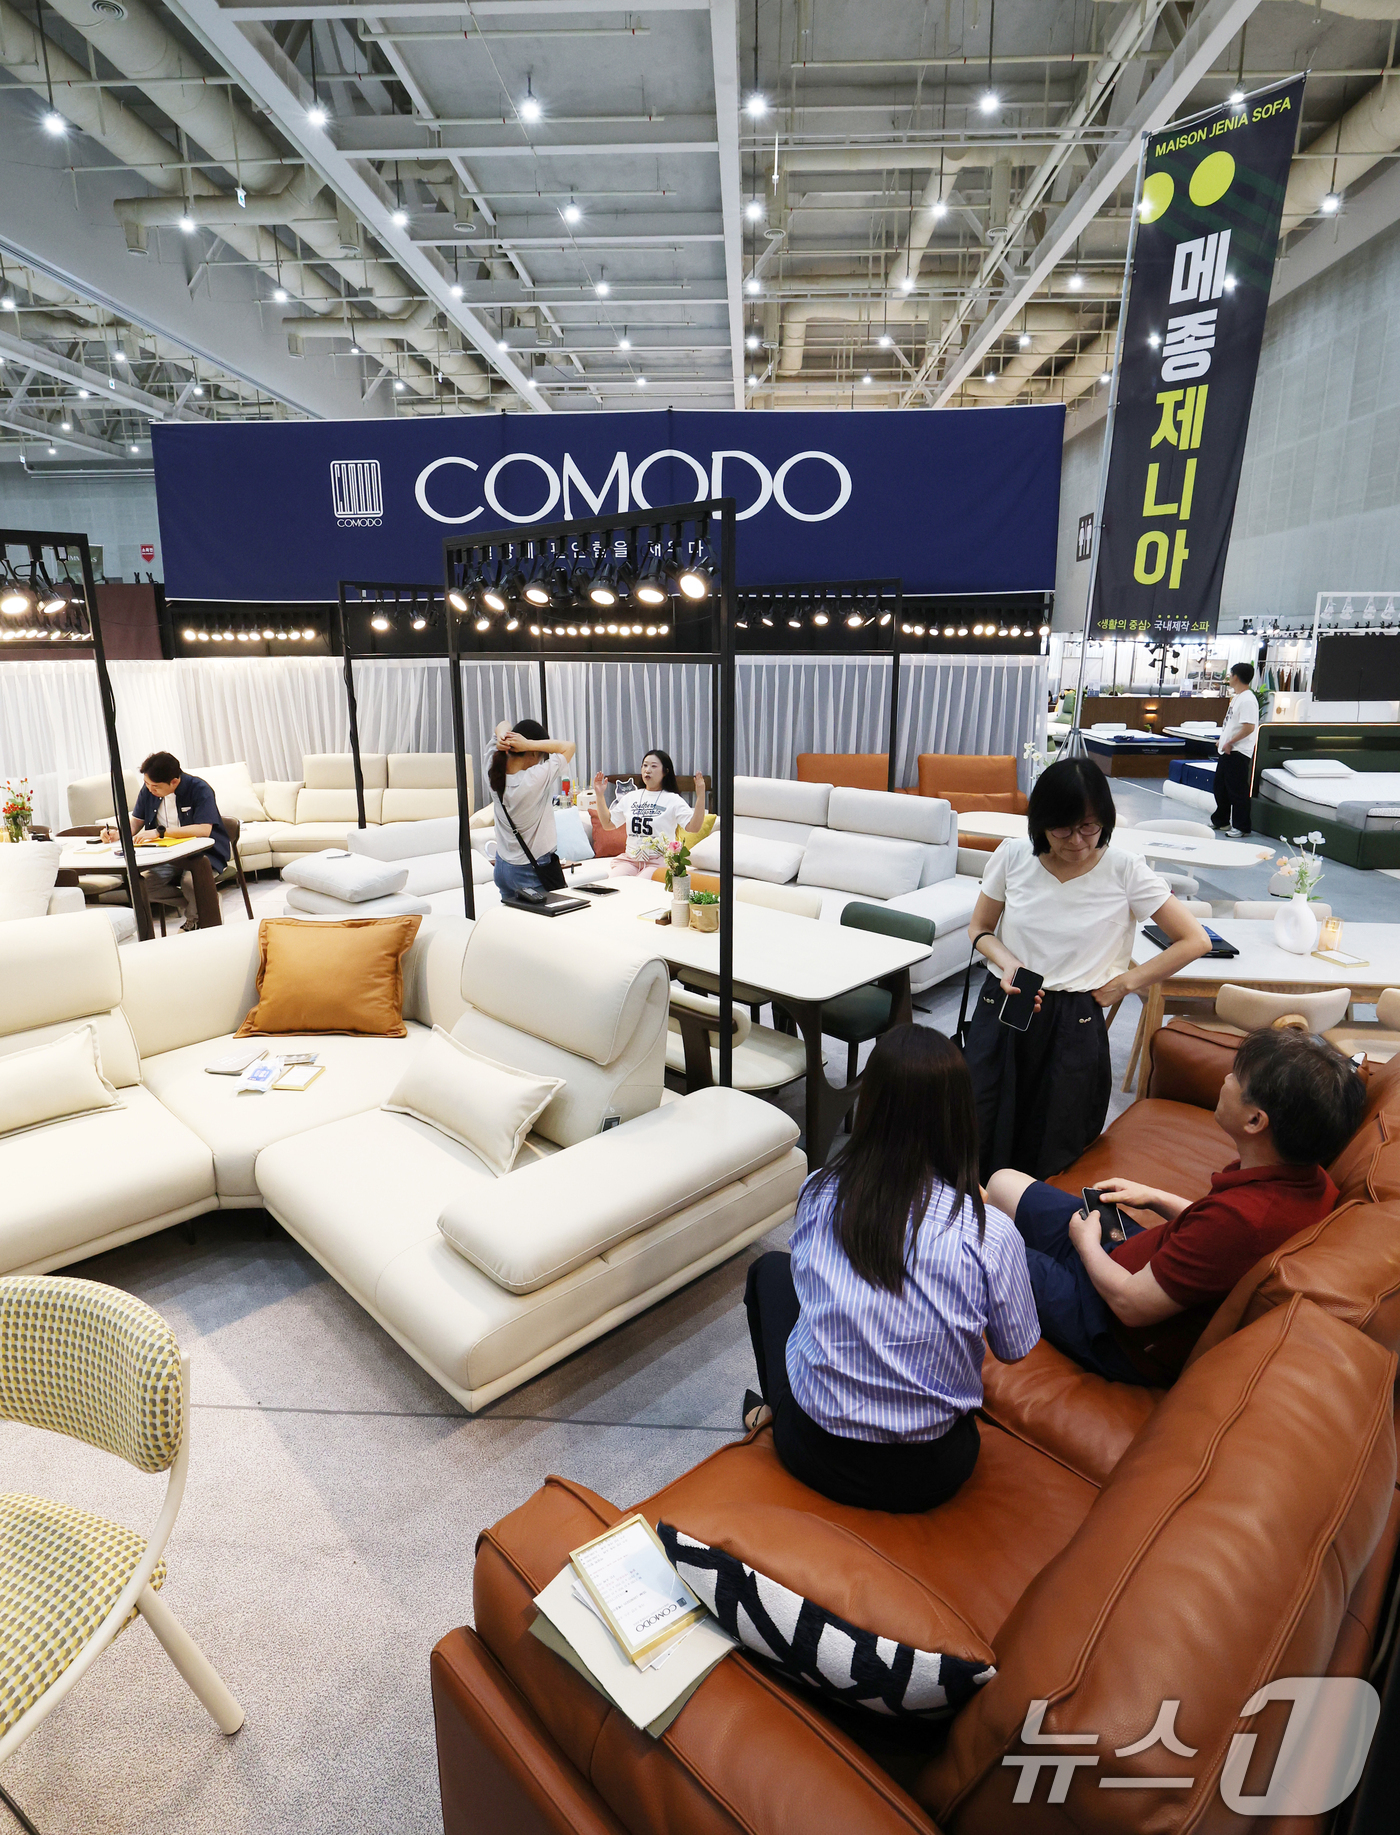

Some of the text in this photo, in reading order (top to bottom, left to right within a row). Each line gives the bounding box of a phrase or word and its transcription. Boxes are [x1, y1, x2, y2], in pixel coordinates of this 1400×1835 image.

[1155, 96, 1292, 157] MAISON JENIA SOFA
[415, 449, 852, 524] COMODO
[337, 518, 382, 527] COMODO
[1190, 621, 1210, 632] 소파
[632, 816, 653, 835] 65
[636, 1604, 677, 1632] COMODO
